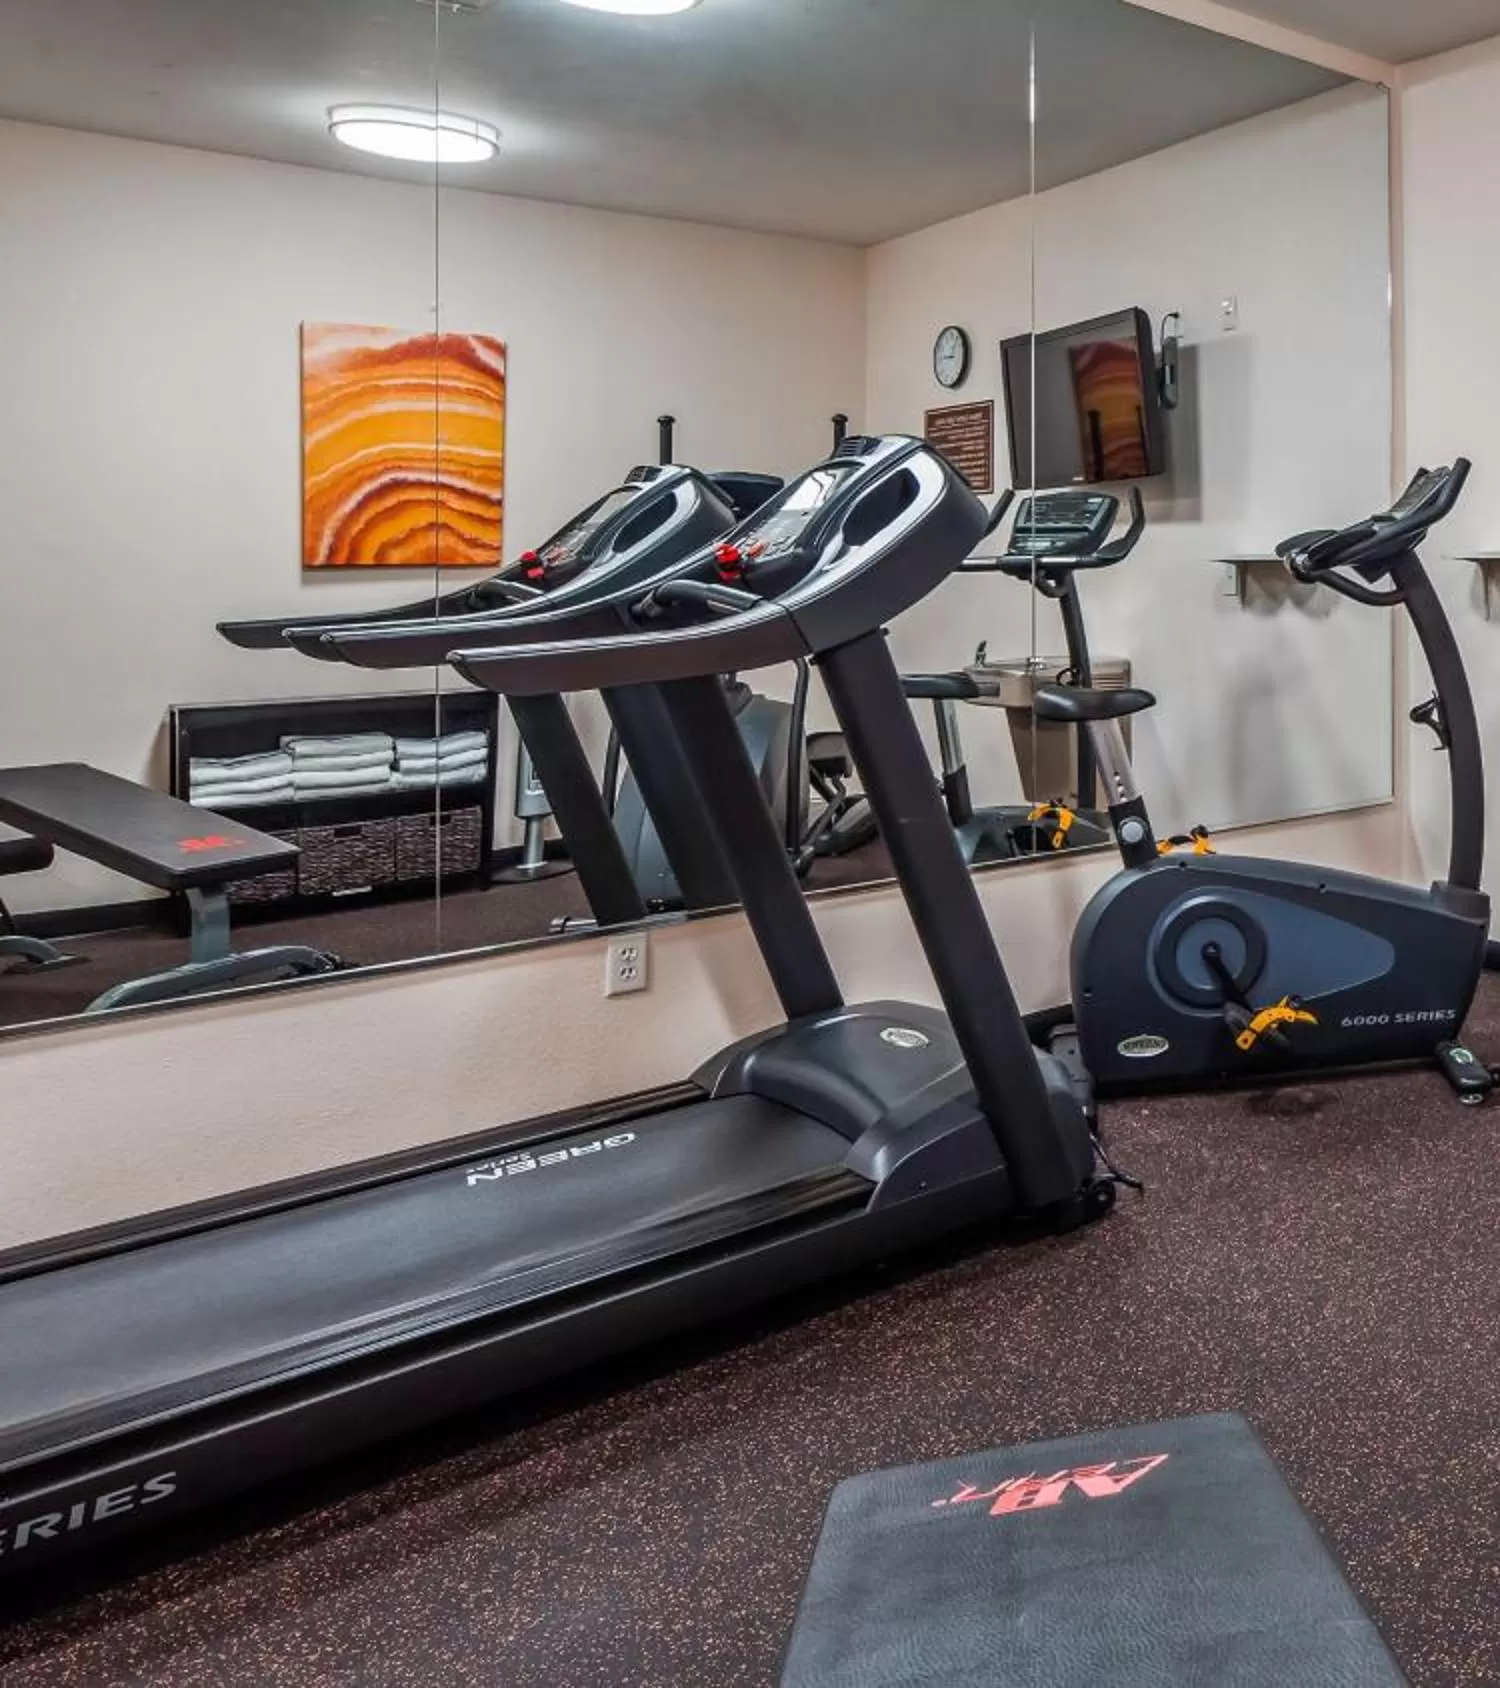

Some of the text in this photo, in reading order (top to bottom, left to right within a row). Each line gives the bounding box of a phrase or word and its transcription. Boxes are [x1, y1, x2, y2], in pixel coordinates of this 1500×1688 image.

[1341, 1009, 1456, 1027] 6000 SERIES
[466, 1132, 636, 1186] GREEN
[0, 1471, 178, 1558] RIES
